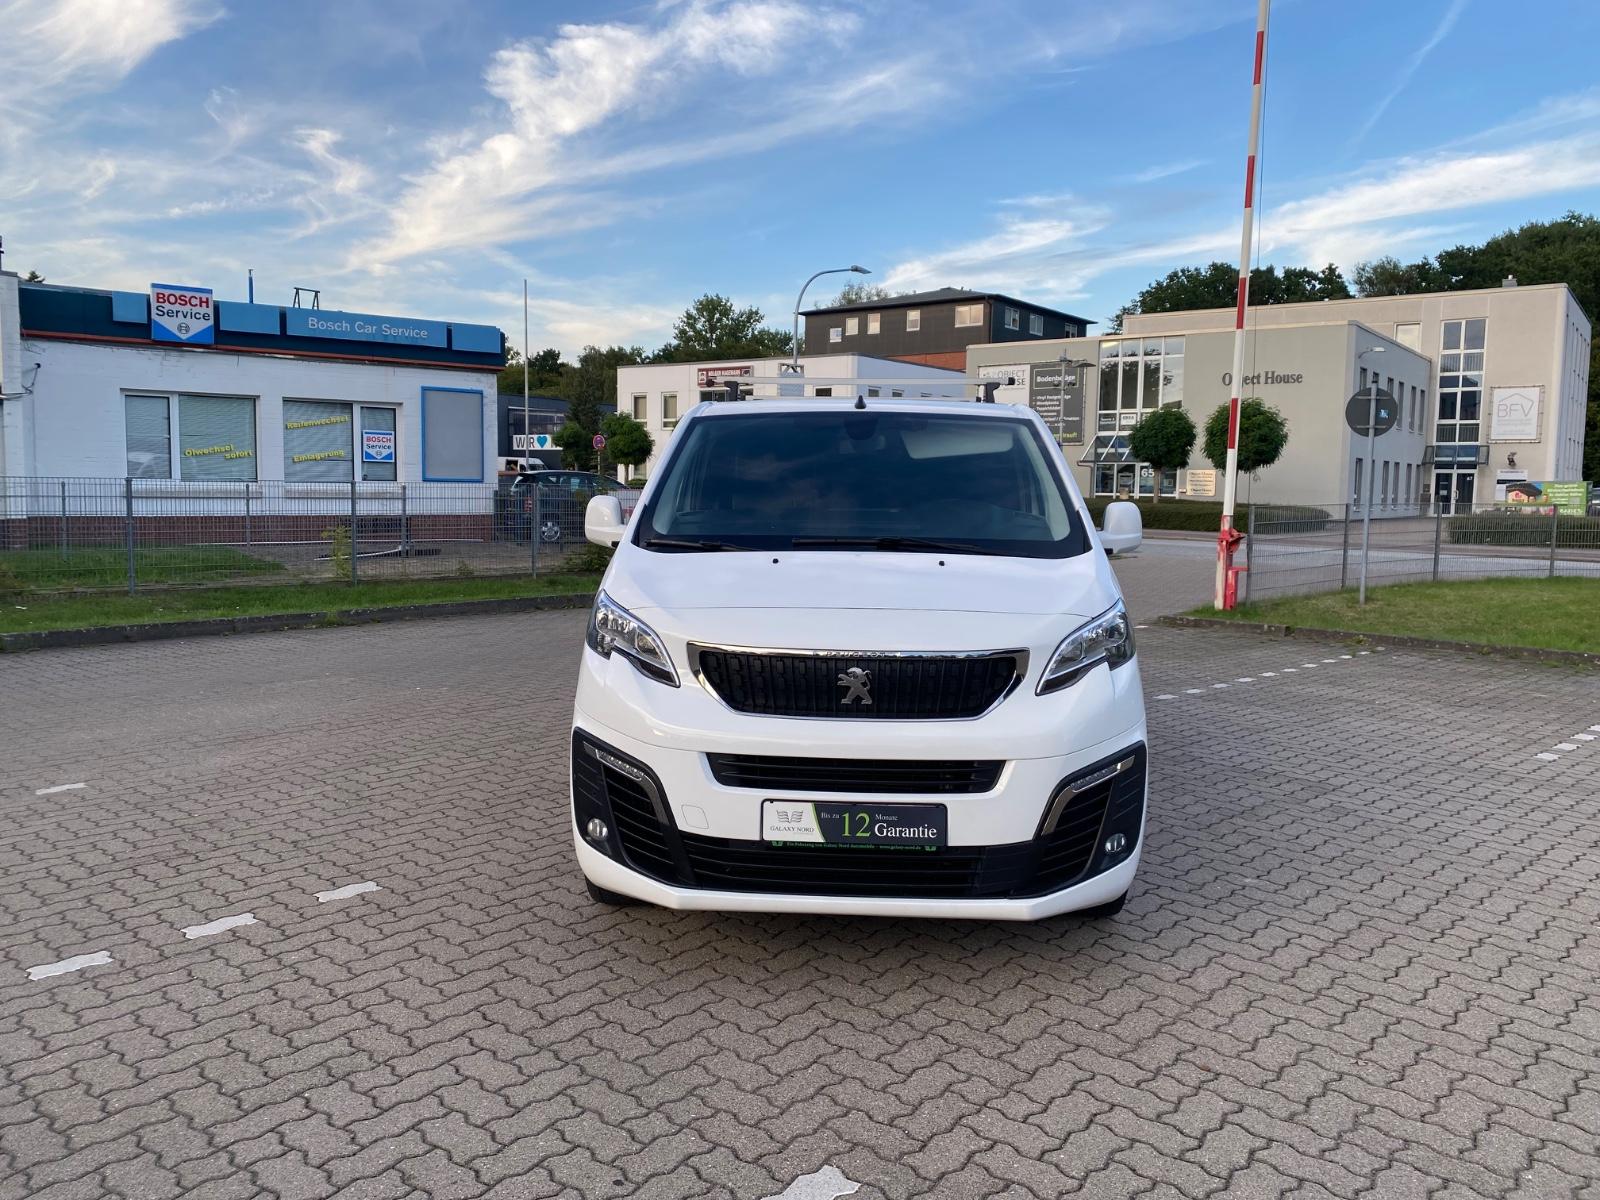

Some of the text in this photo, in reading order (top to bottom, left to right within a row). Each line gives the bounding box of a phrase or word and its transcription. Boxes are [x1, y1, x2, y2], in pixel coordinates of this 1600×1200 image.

[156, 292, 210, 308] BOSCH
[155, 305, 211, 321] Service
[308, 317, 428, 338] Bosch Car Service
[1222, 371, 1303, 388] Oject House
[1497, 402, 1534, 417] BFV
[515, 436, 535, 449] WR
[1141, 468, 1154, 477] 65
[841, 812, 871, 837] 12
[874, 822, 937, 838] Garantie
